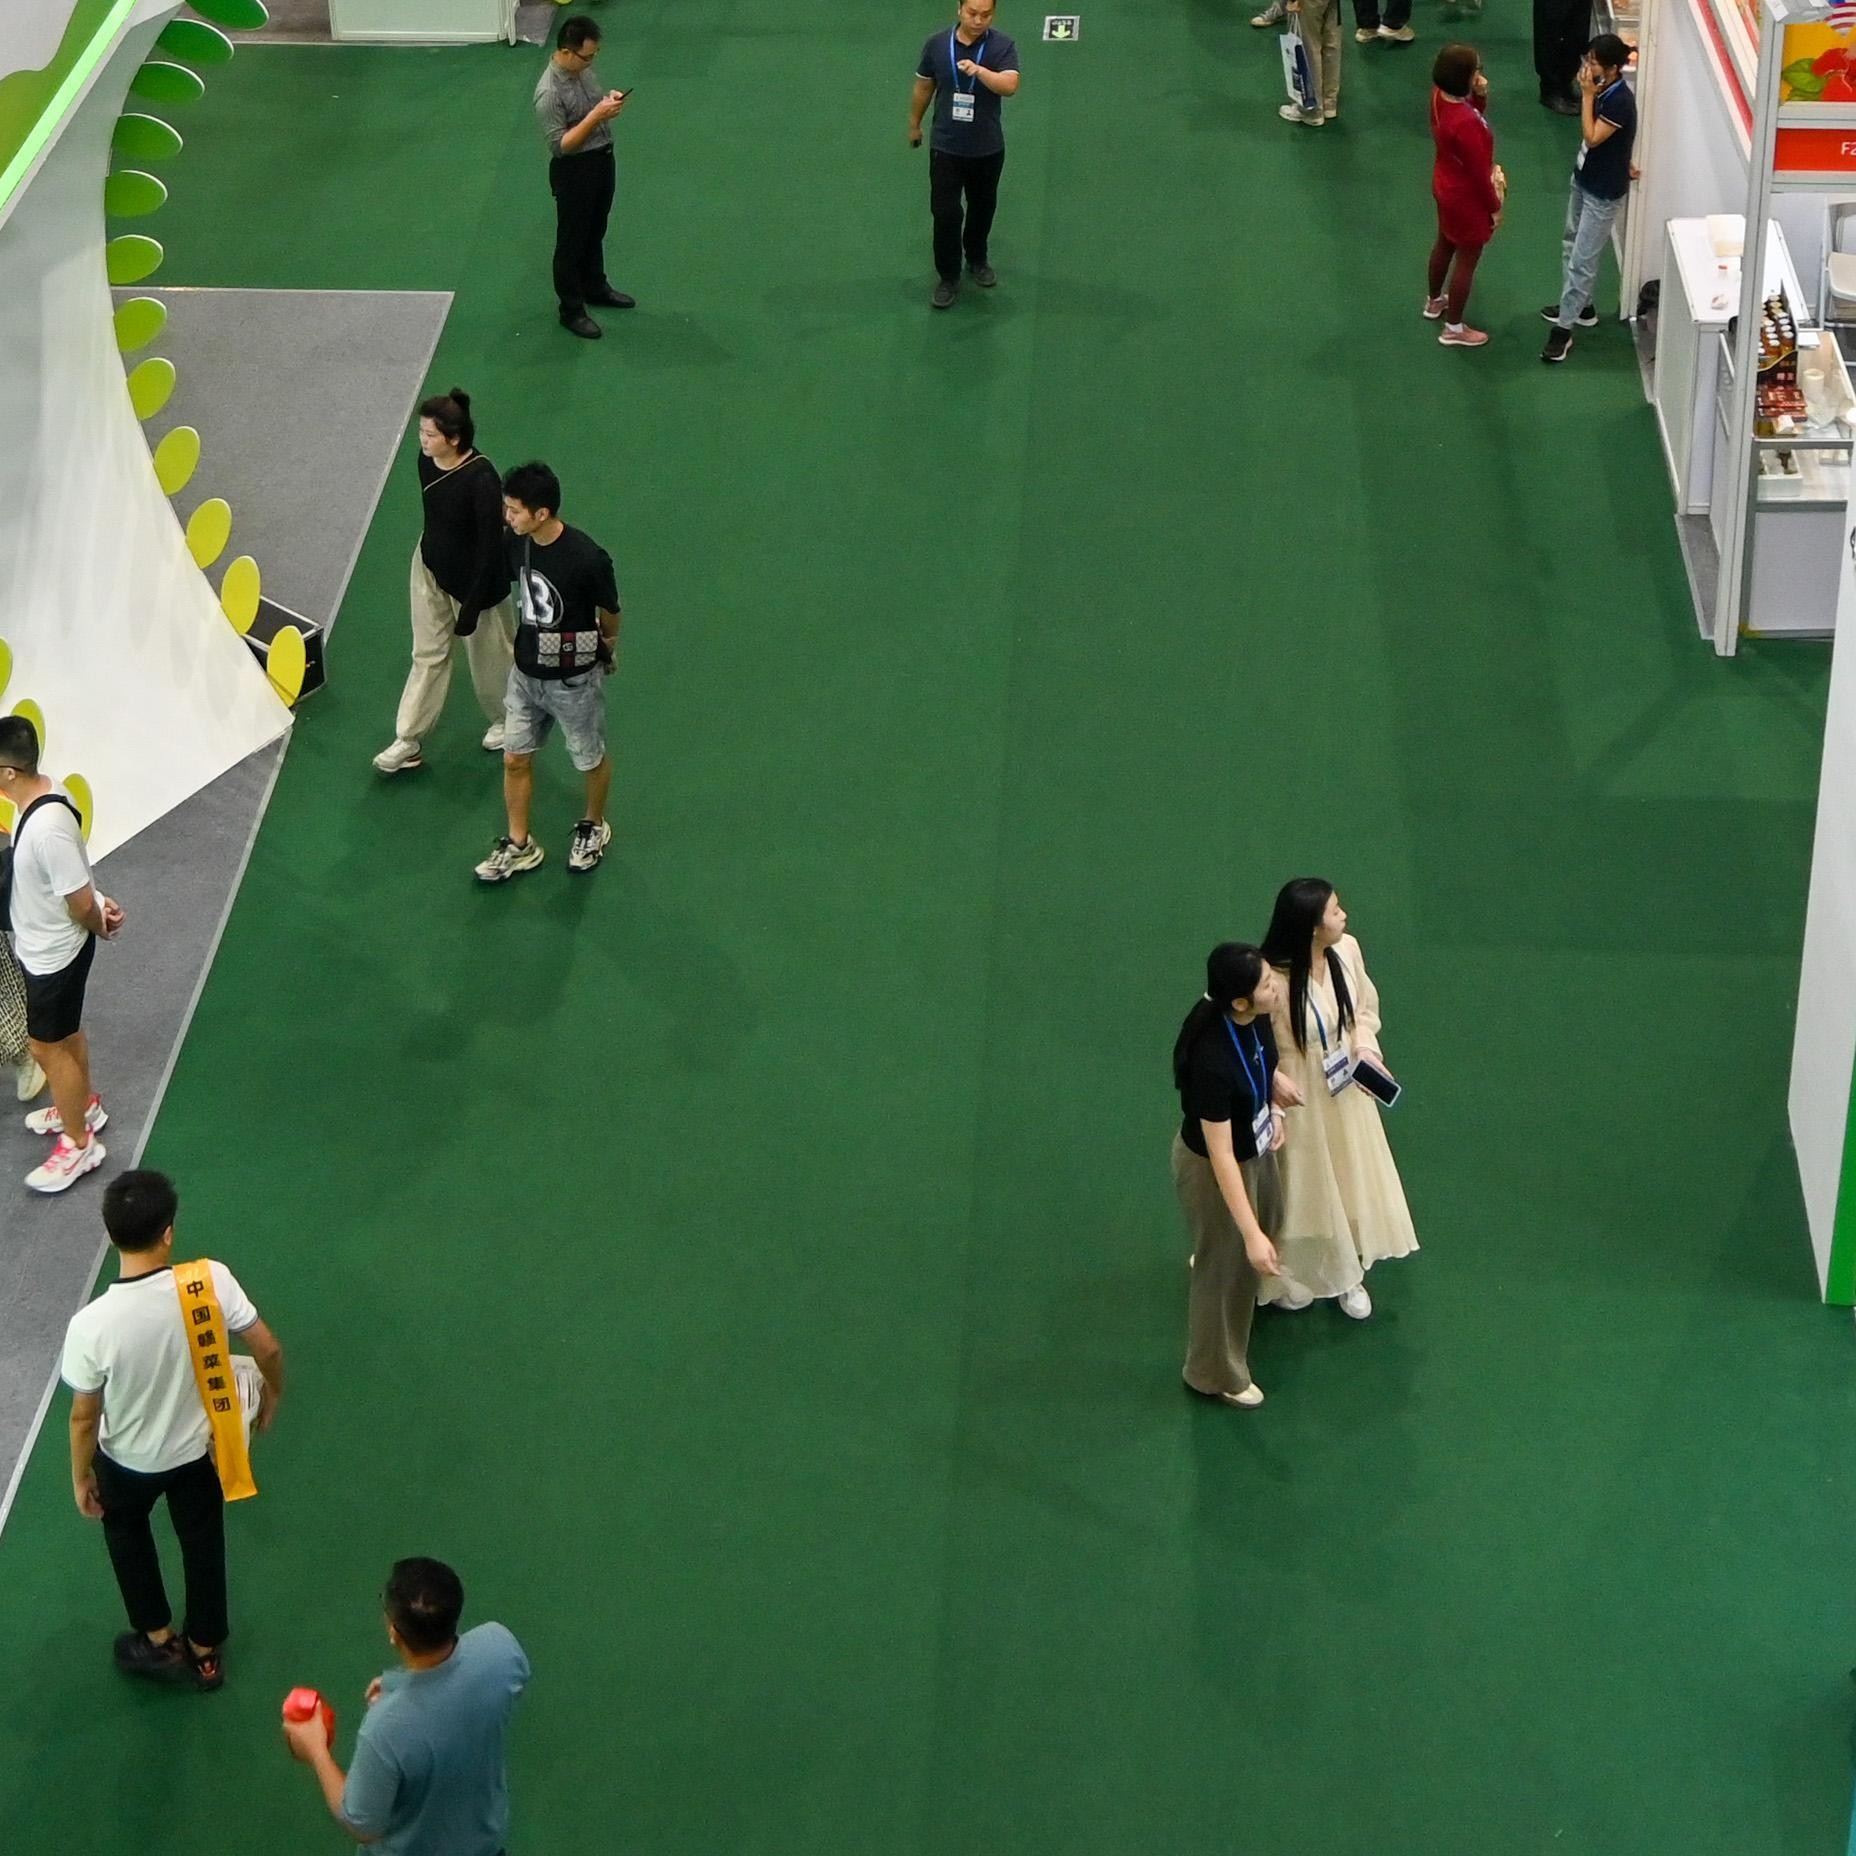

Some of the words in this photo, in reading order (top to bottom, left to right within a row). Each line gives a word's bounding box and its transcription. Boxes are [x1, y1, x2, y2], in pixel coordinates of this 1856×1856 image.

[185, 1279, 232, 1415] 中国赣菜集团
